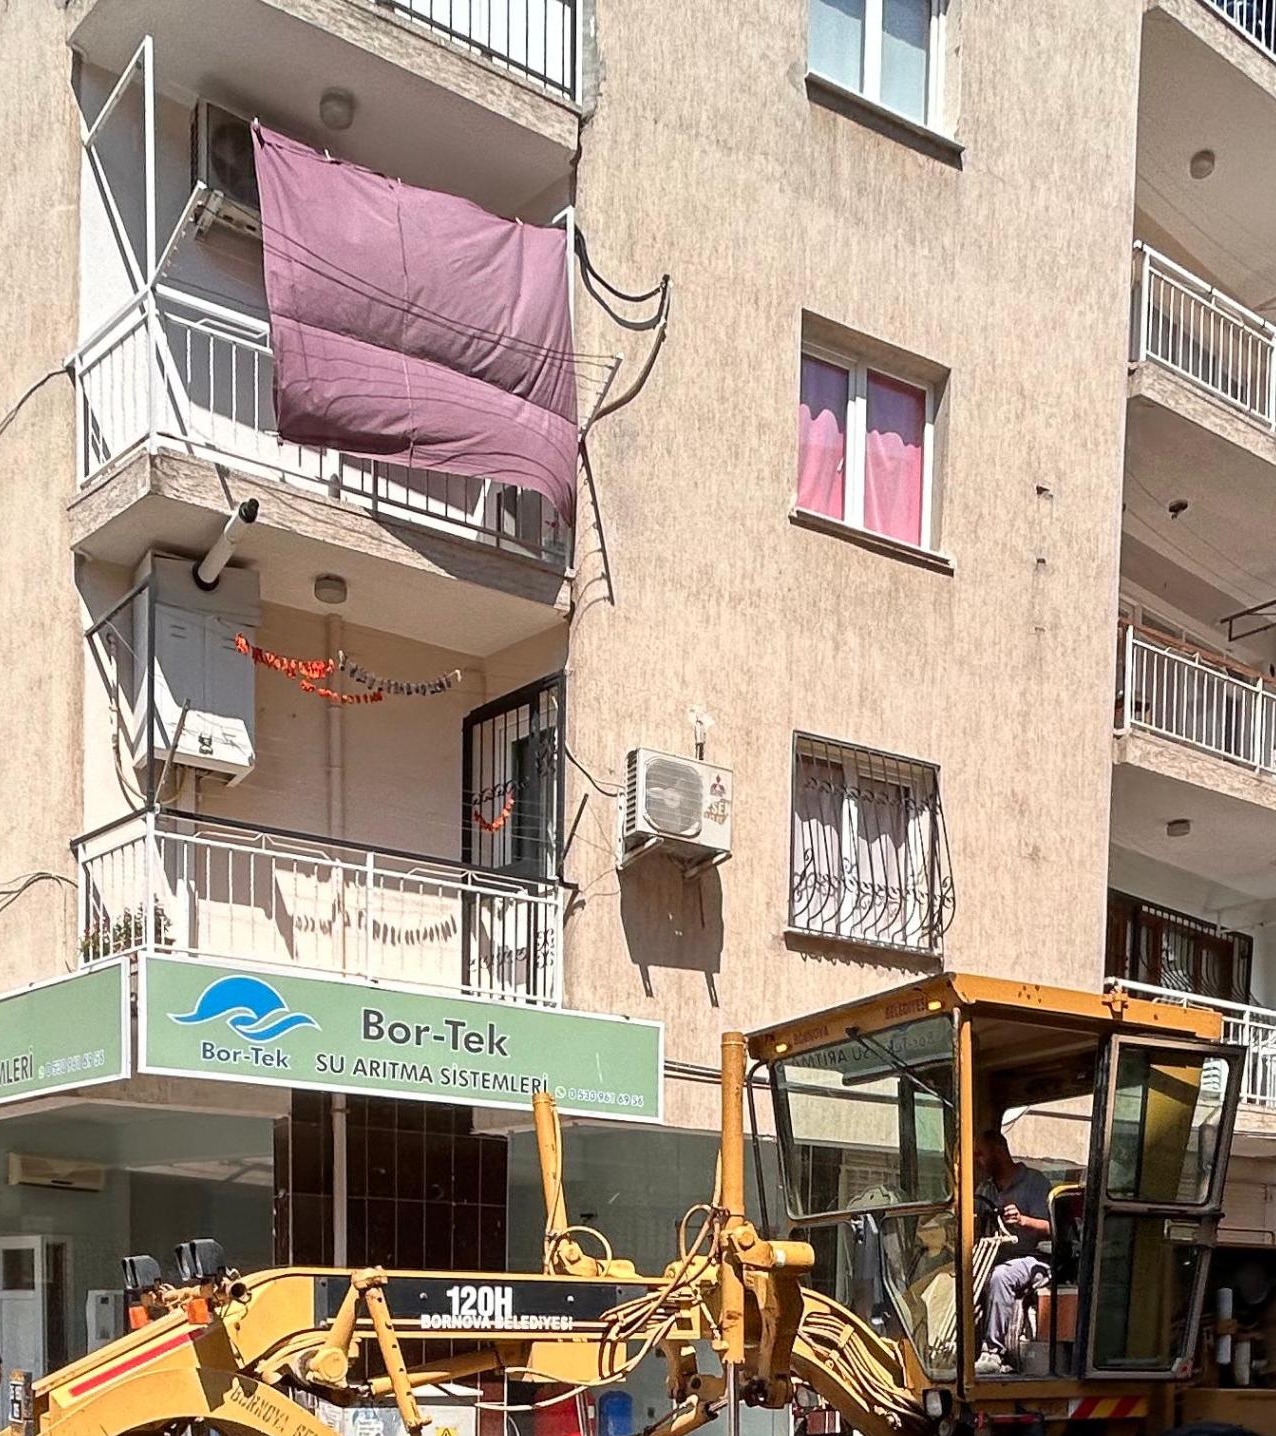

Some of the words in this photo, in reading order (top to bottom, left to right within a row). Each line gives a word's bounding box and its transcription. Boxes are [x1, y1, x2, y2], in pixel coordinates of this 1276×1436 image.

[362, 1008, 508, 1056] Bor-Tek
[202, 1041, 289, 1069] Bor-Tek
[317, 1054, 344, 1073] SU
[353, 1058, 433, 1083] ARITMA
[441, 1064, 547, 1094] SİSTEMLERİ
[446, 1285, 513, 1317] 120H
[420, 1314, 491, 1329] BORNOVA
